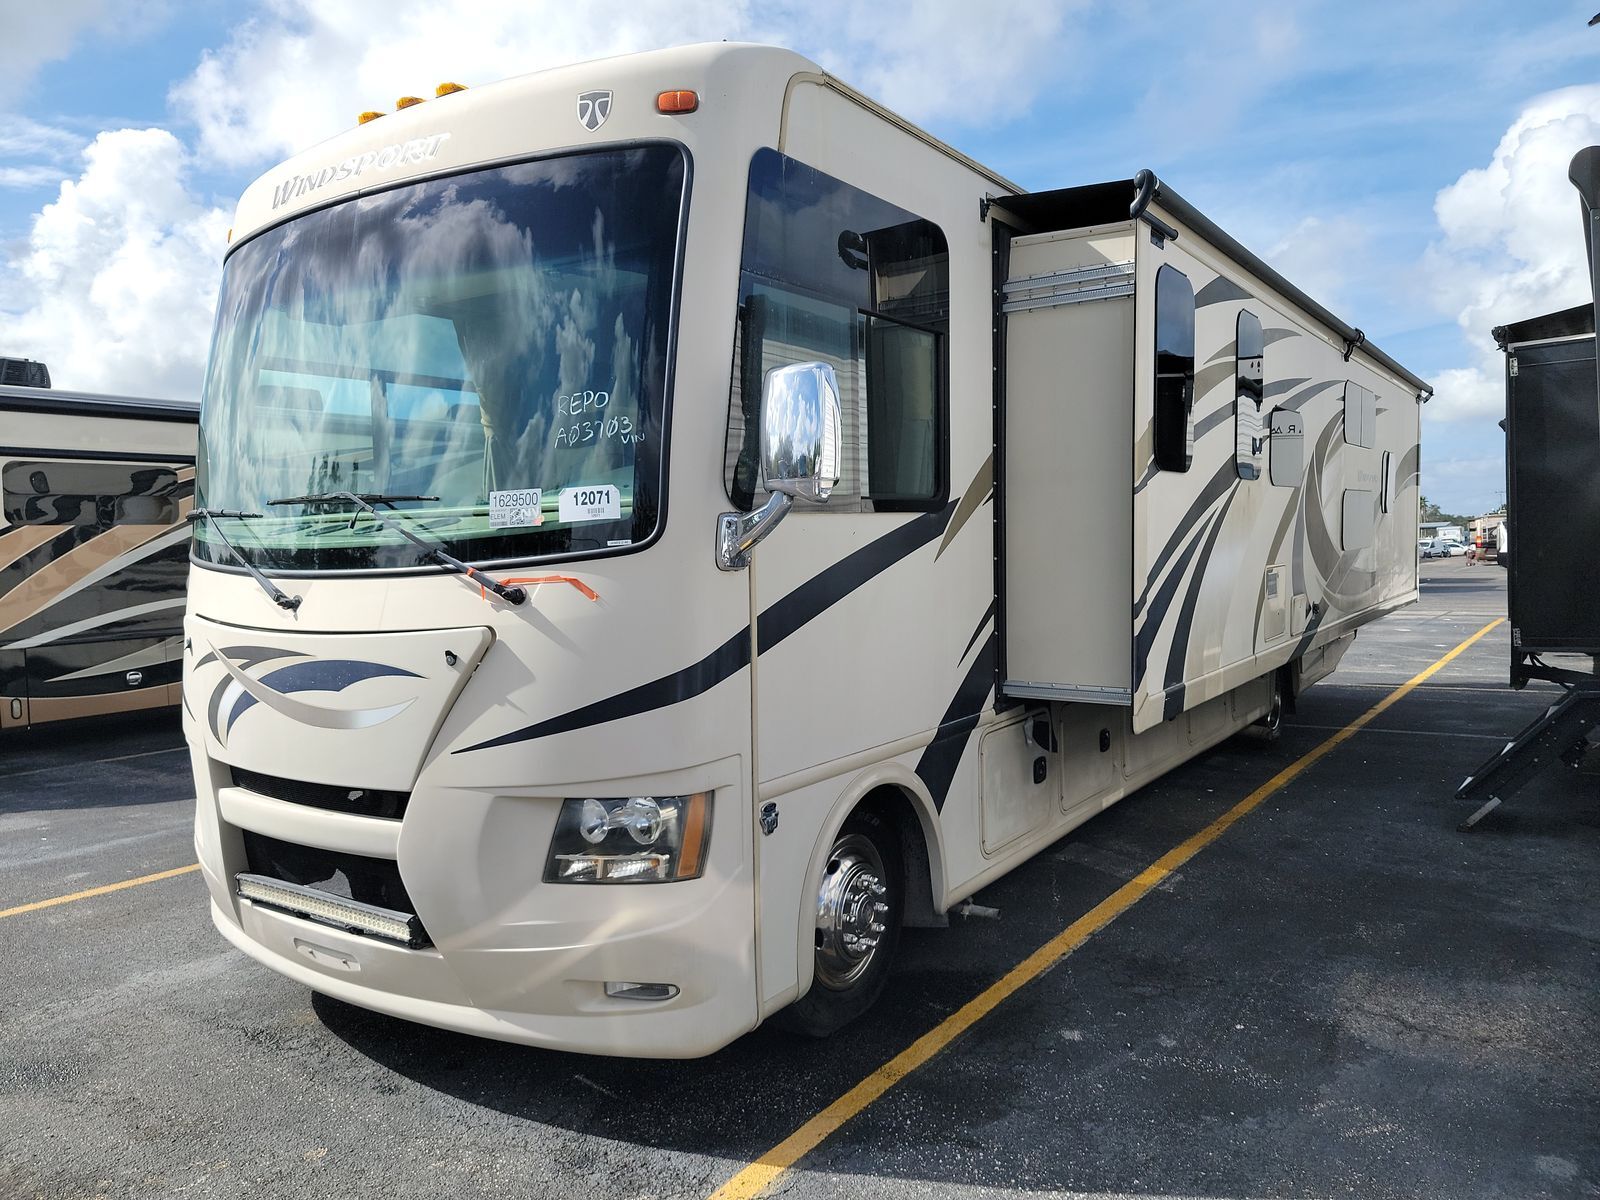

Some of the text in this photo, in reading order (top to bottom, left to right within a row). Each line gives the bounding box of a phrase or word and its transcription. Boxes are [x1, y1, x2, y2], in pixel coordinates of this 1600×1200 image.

[271, 132, 451, 210] WINDSPORT
[558, 390, 609, 415] REPO
[620, 432, 646, 444] VIN
[493, 492, 539, 508] 1629500
[573, 489, 611, 506] 12071
